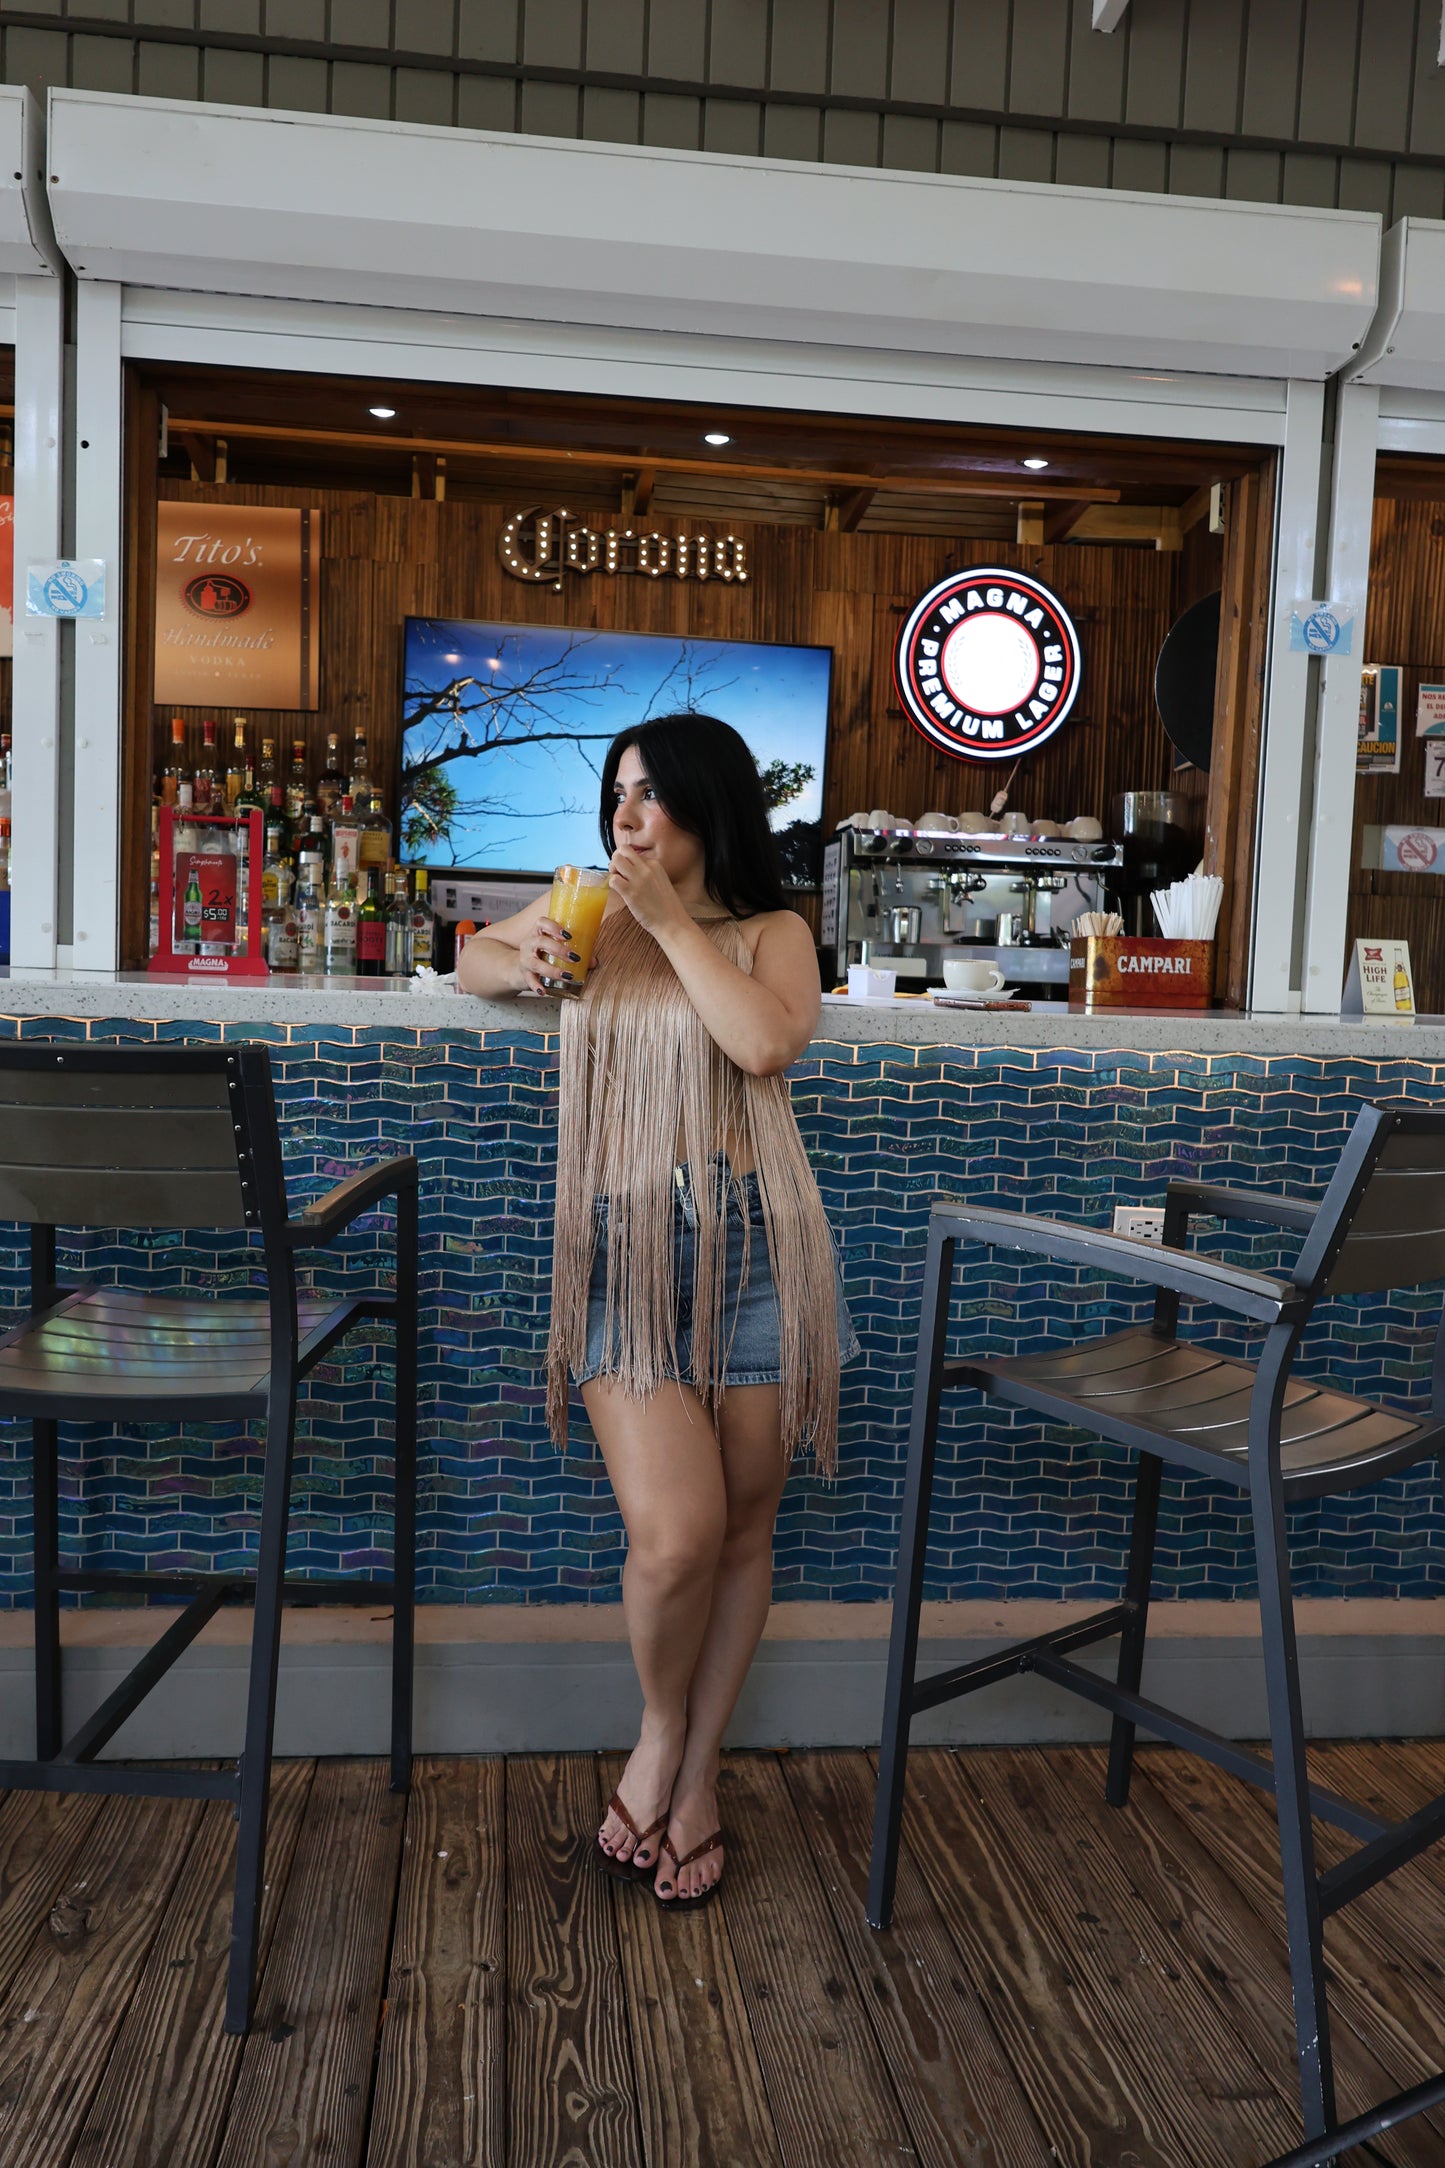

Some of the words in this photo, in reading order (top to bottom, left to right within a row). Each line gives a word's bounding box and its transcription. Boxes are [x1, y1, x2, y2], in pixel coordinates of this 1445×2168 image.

[173, 533, 263, 566] Tito's
[500, 504, 751, 590] Corona
[939, 588, 1044, 629] MAGNA
[162, 626, 275, 650] Handmade
[190, 655, 246, 667] VODKA
[918, 638, 1004, 738] PREMIUM
[1014, 644, 1063, 730] LAGER
[193, 958, 224, 966] MAGNA
[1070, 957, 1085, 969] CAMPARI
[1117, 955, 1192, 974] CAMPARI
[1363, 965, 1387, 975] HIGH
[1366, 975, 1386, 983] LIFE
